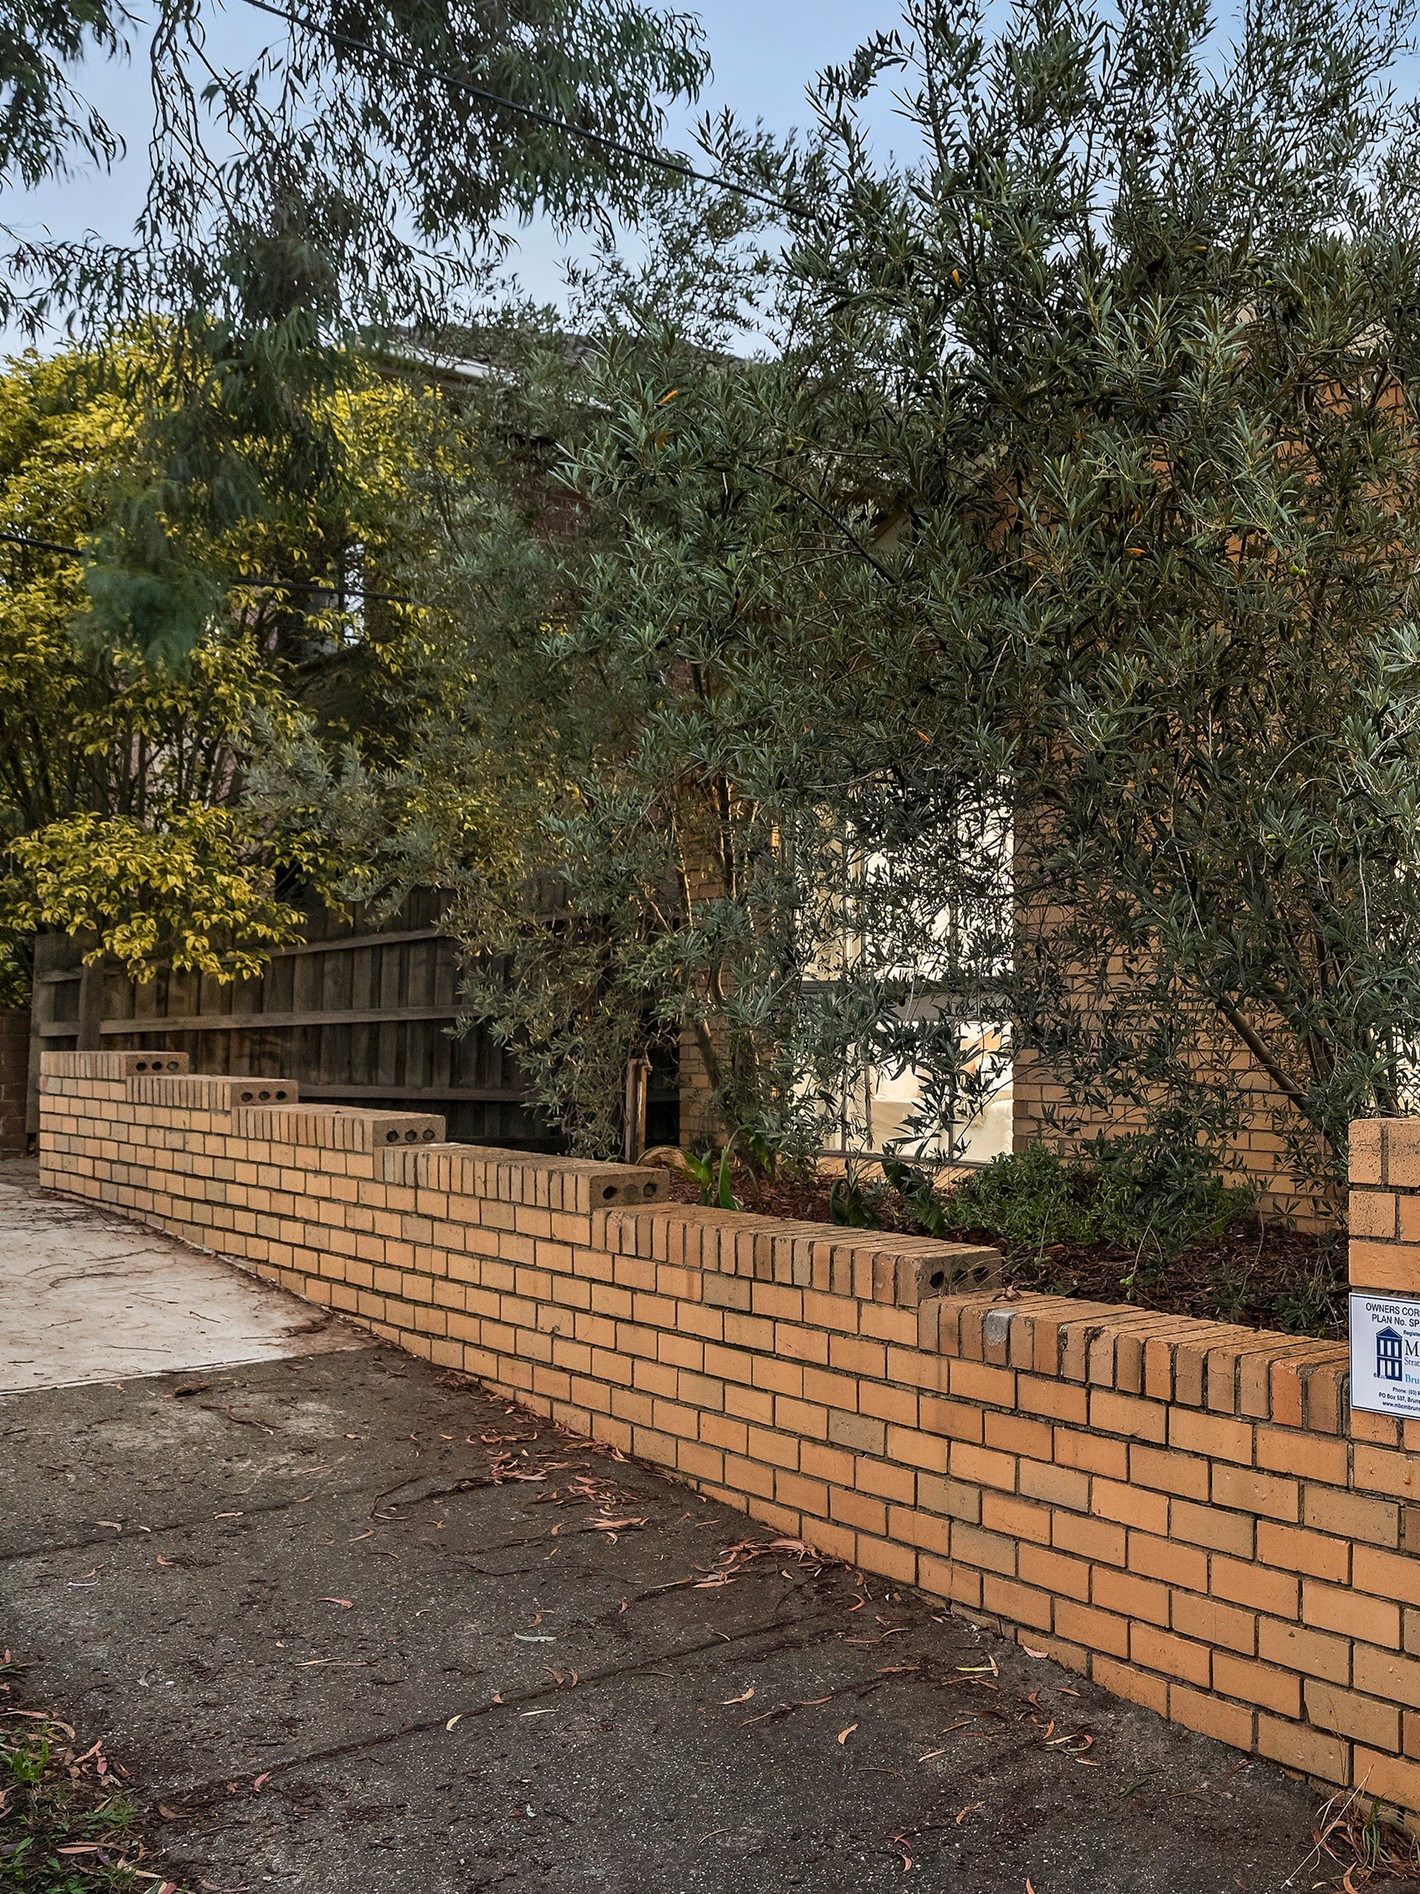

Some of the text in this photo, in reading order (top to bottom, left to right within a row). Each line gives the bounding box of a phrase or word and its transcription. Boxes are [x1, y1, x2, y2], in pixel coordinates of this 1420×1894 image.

[1365, 1302, 1400, 1315] OWNERS
[1371, 1313, 1393, 1324] PLAN
[1394, 1317, 1407, 1327] No.
[1408, 1318, 1420, 1328] SP
